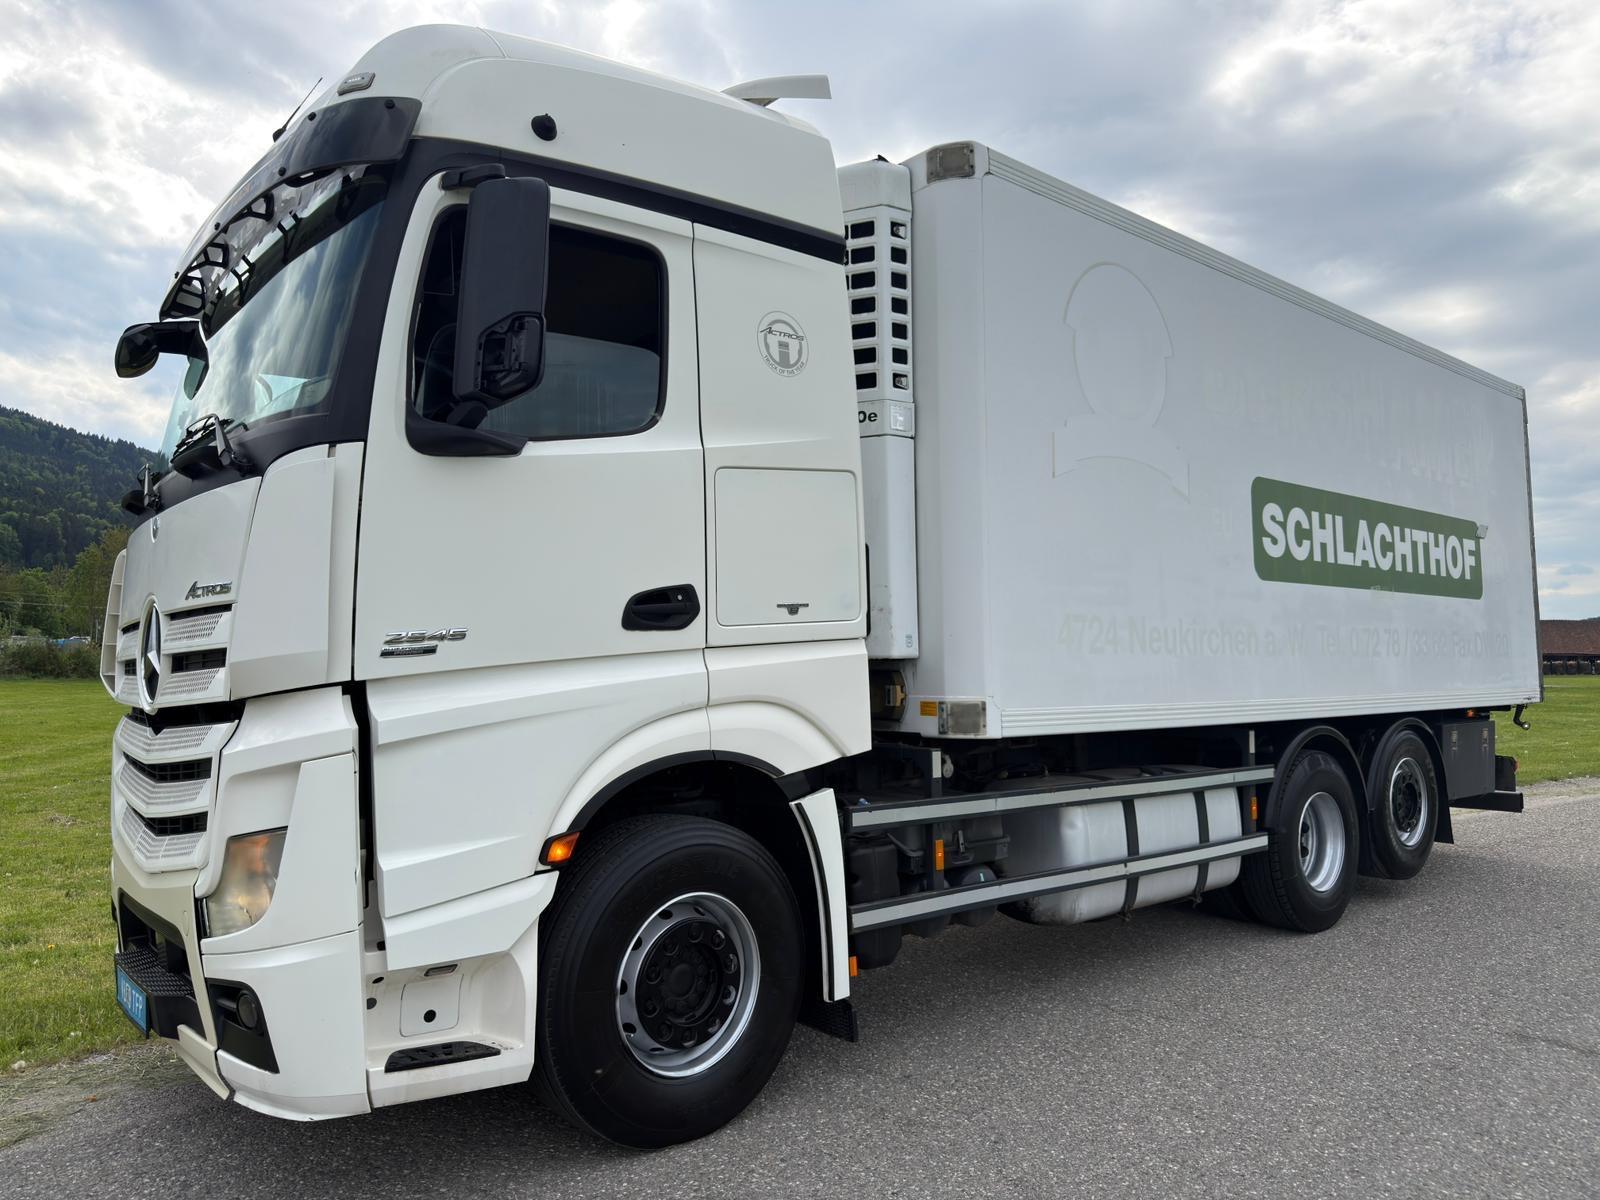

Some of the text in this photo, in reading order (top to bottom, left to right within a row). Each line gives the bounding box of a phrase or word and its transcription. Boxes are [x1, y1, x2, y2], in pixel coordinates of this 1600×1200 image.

[1262, 503, 1475, 580] SCHLACHTHOF
[1057, 614, 1118, 655] 4724
[1128, 615, 1259, 656] Neukirchen
